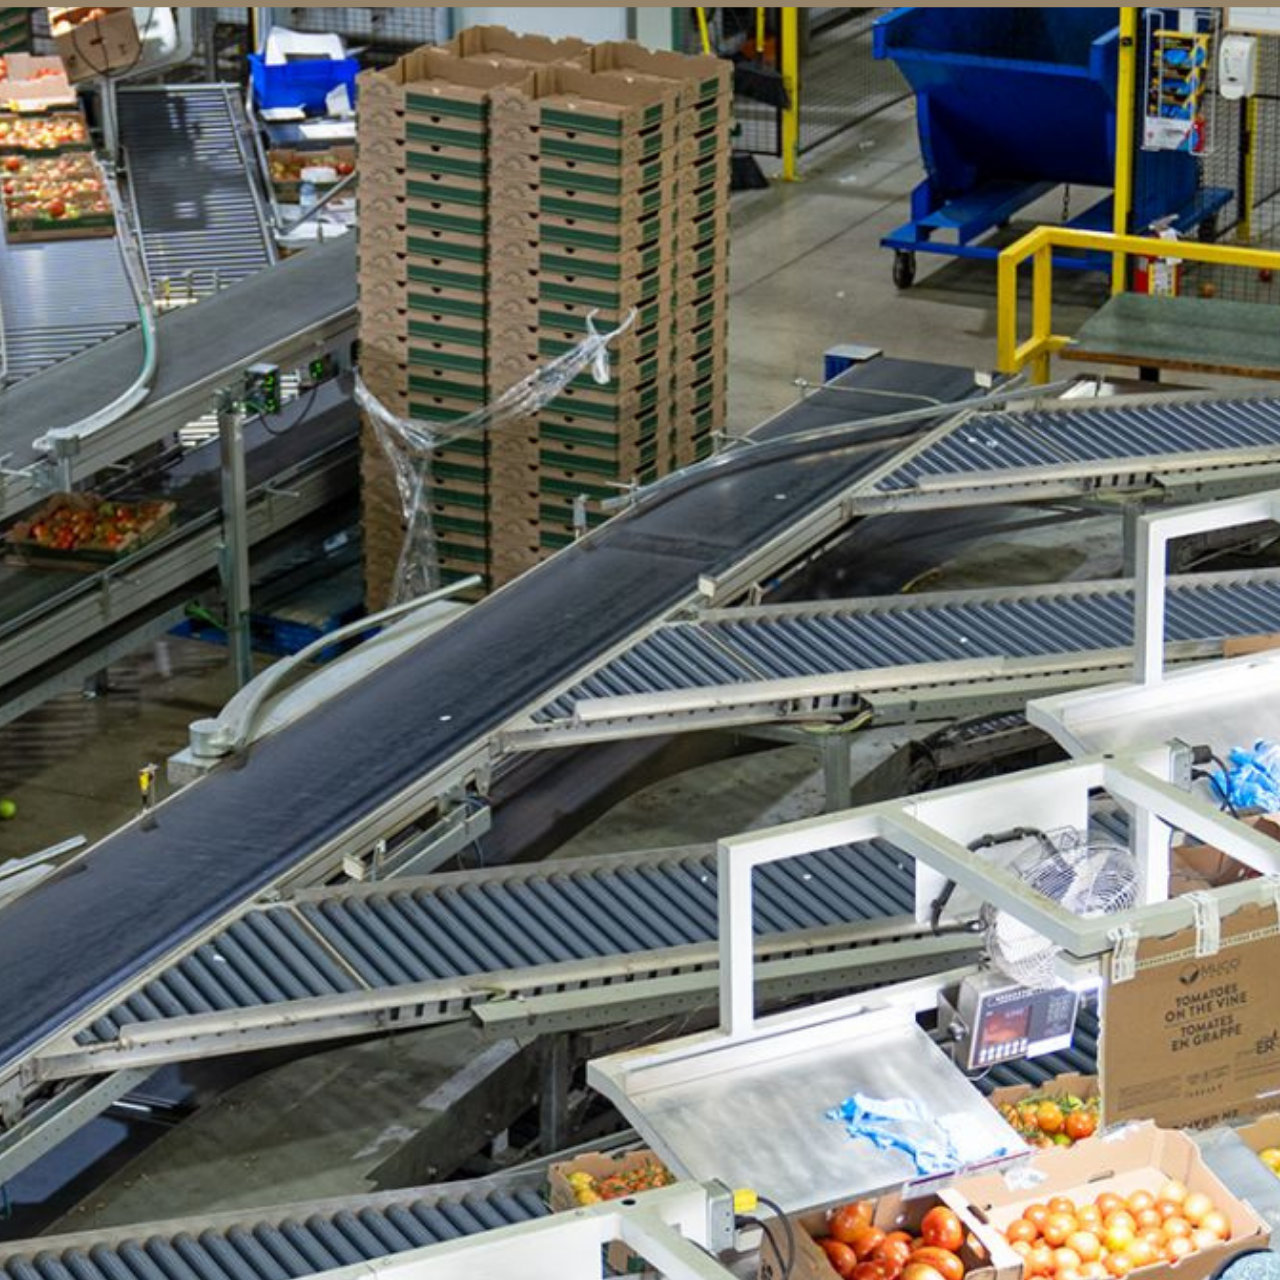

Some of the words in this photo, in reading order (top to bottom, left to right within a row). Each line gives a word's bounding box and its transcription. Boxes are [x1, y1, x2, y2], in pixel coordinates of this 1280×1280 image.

[1165, 1008, 1185, 1022] ON
[1189, 1000, 1212, 1017] THE
[1216, 991, 1247, 1008] VINE
[1176, 983, 1238, 1007] TOMATOES
[1171, 1038, 1189, 1052] EN
[1193, 1023, 1242, 1047] GRAPPE
[1181, 1015, 1234, 1037] TOMATES
